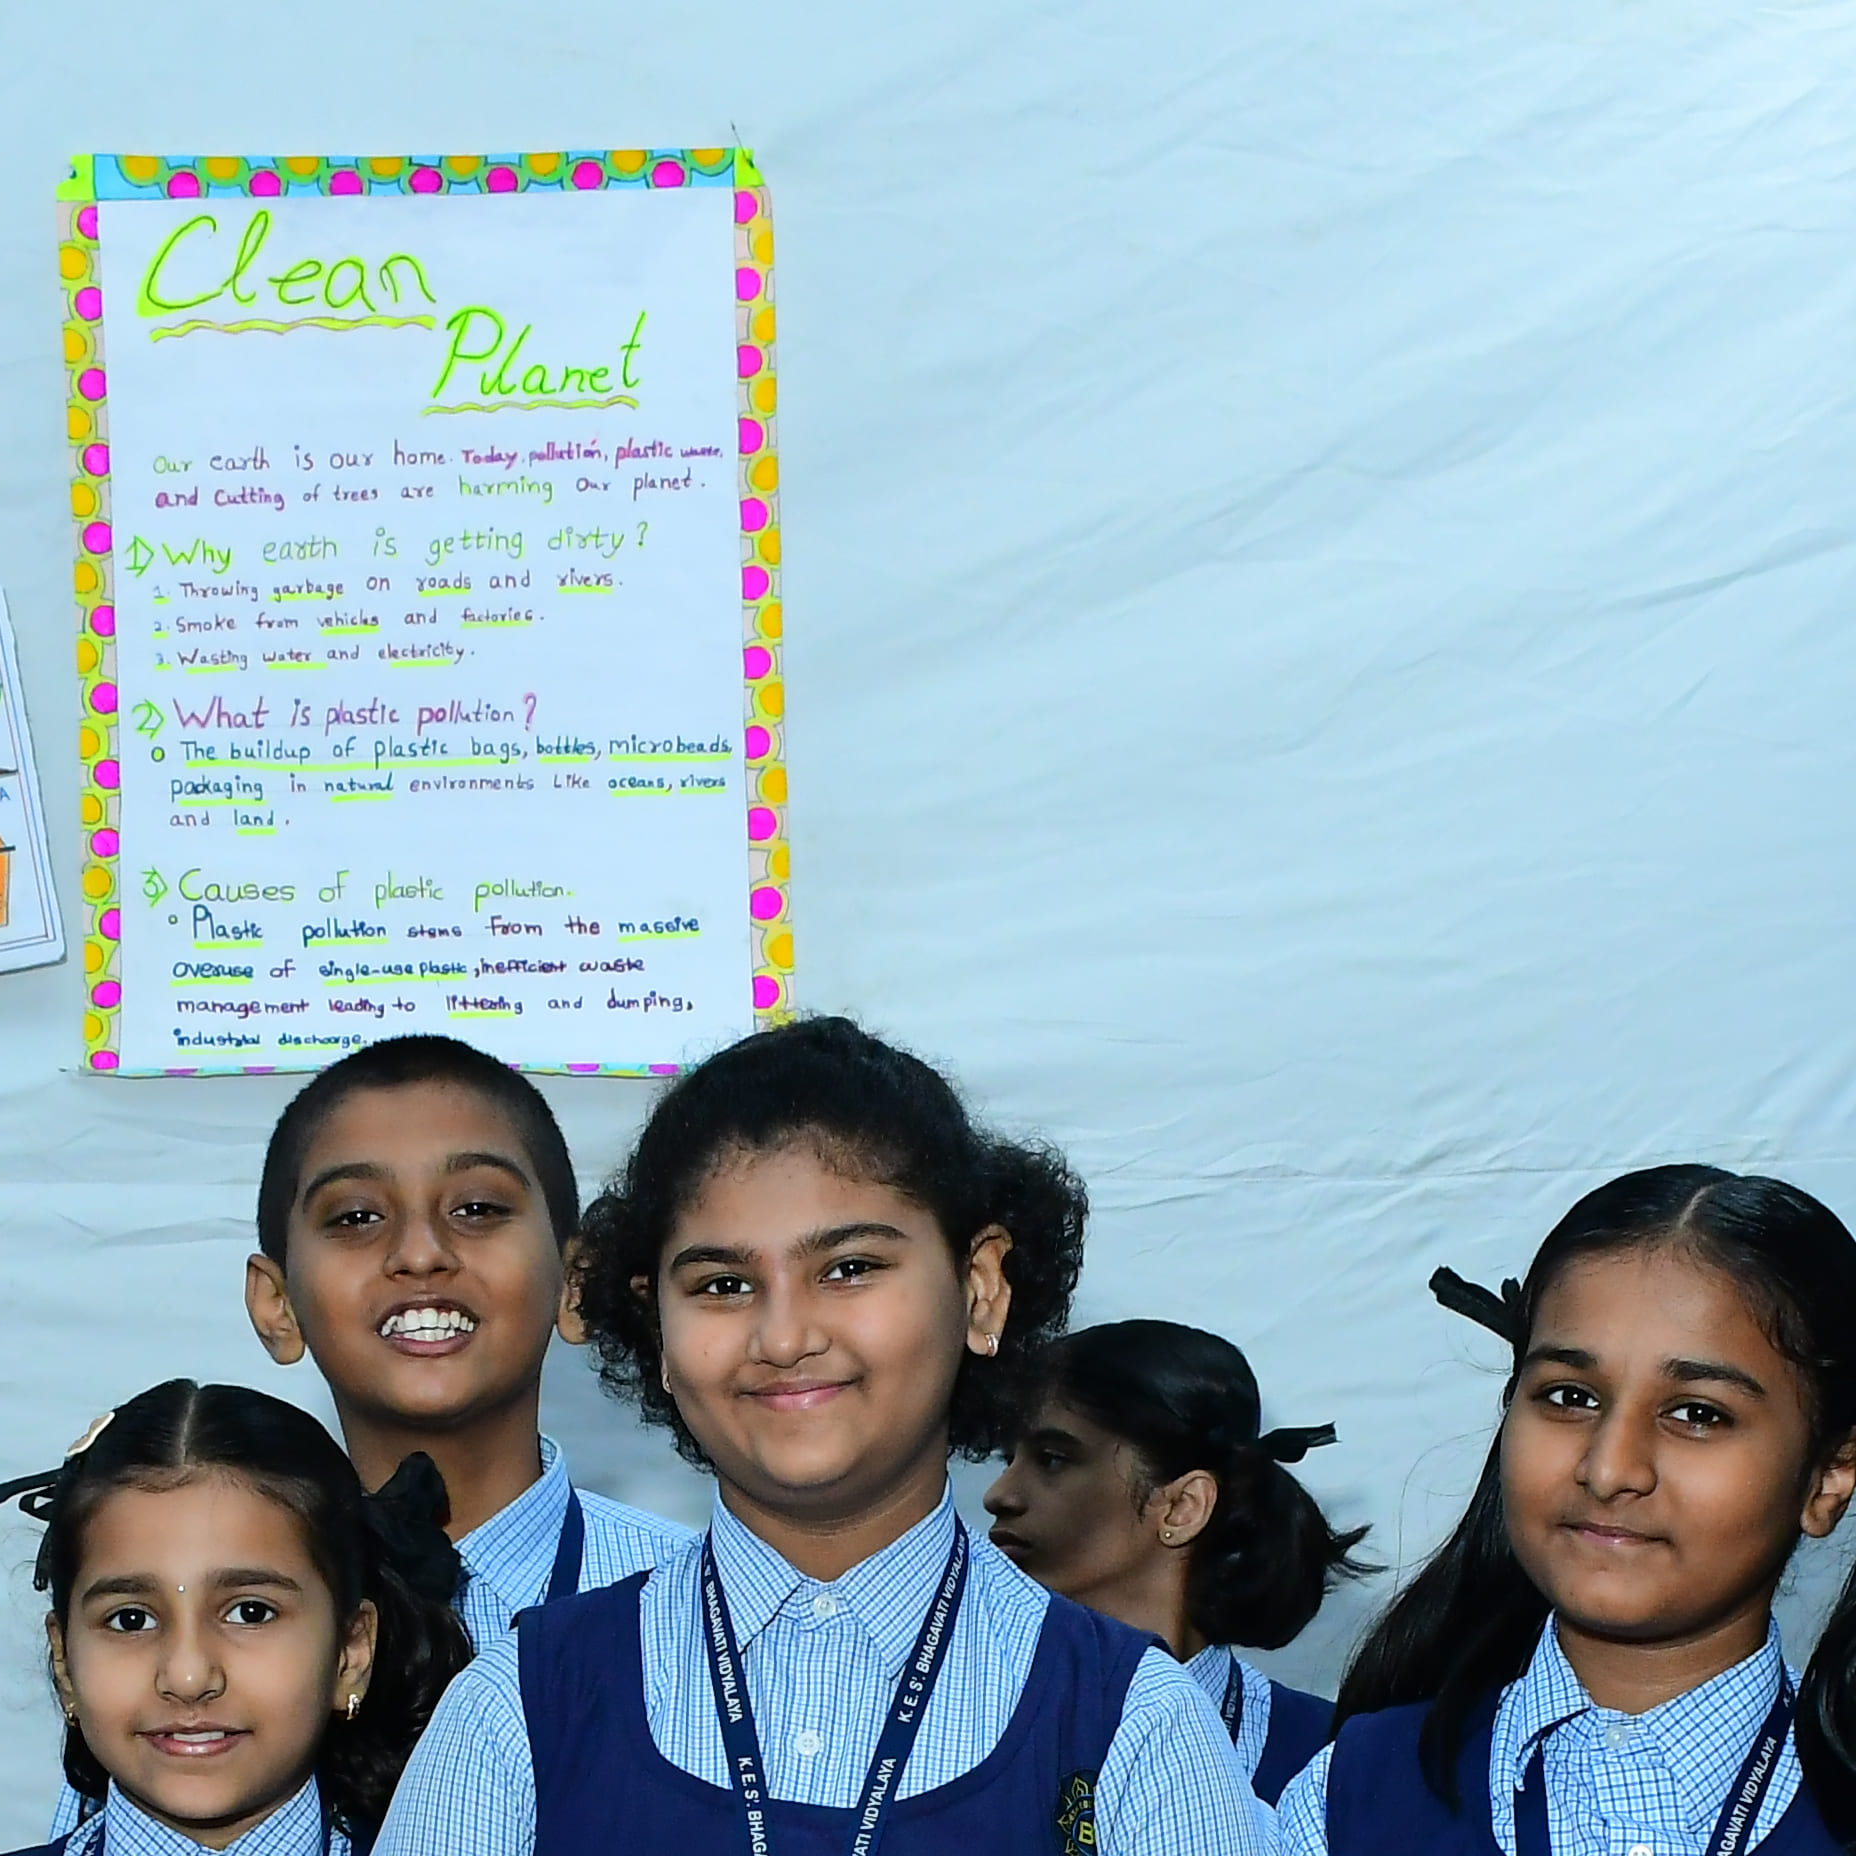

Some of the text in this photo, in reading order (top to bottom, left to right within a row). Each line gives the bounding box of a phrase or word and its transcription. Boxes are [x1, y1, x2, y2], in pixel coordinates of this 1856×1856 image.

[137, 210, 435, 315] Clean
[432, 307, 646, 398] Planet
[153, 456, 192, 474] Our
[210, 446, 270, 470] earth
[294, 444, 314, 470] is
[616, 438, 672, 468] plastic
[155, 486, 198, 508] and
[303, 484, 321, 502] of
[334, 485, 378, 501] trees
[401, 485, 434, 498] are
[459, 476, 552, 503] harming
[162, 528, 522, 574] Why earth is getting
[180, 570, 530, 602] Throwing garbage on roads and
[175, 616, 236, 633] Smoke
[256, 613, 298, 630] from
[404, 608, 437, 624] and
[177, 649, 248, 669] Wasting
[263, 648, 311, 663] water
[327, 645, 360, 662] and
[173, 697, 399, 737] What is plastic
[181, 742, 216, 761] The
[230, 735, 311, 767] buildup
[333, 736, 357, 759] of
[375, 734, 449, 770] plastic
[171, 775, 264, 802] packaging
[290, 773, 306, 791] in
[325, 773, 394, 793] natural
[409, 775, 534, 792] environments
[680, 776, 725, 788] rivers
[170, 811, 210, 827] and
[178, 868, 444, 908] Causes of plastic
[193, 904, 263, 939] Plastic
[302, 918, 387, 948] pollution
[565, 915, 601, 935] the
[618, 917, 700, 934] massive
[270, 959, 296, 978] of
[419, 961, 467, 978] plastic
[580, 958, 644, 972] waste
[177, 999, 310, 1018] management
[329, 998, 384, 1018] leading
[392, 996, 415, 1012] to
[548, 996, 582, 1009] and
[860, 1758, 897, 1830] VIDYALAYA
